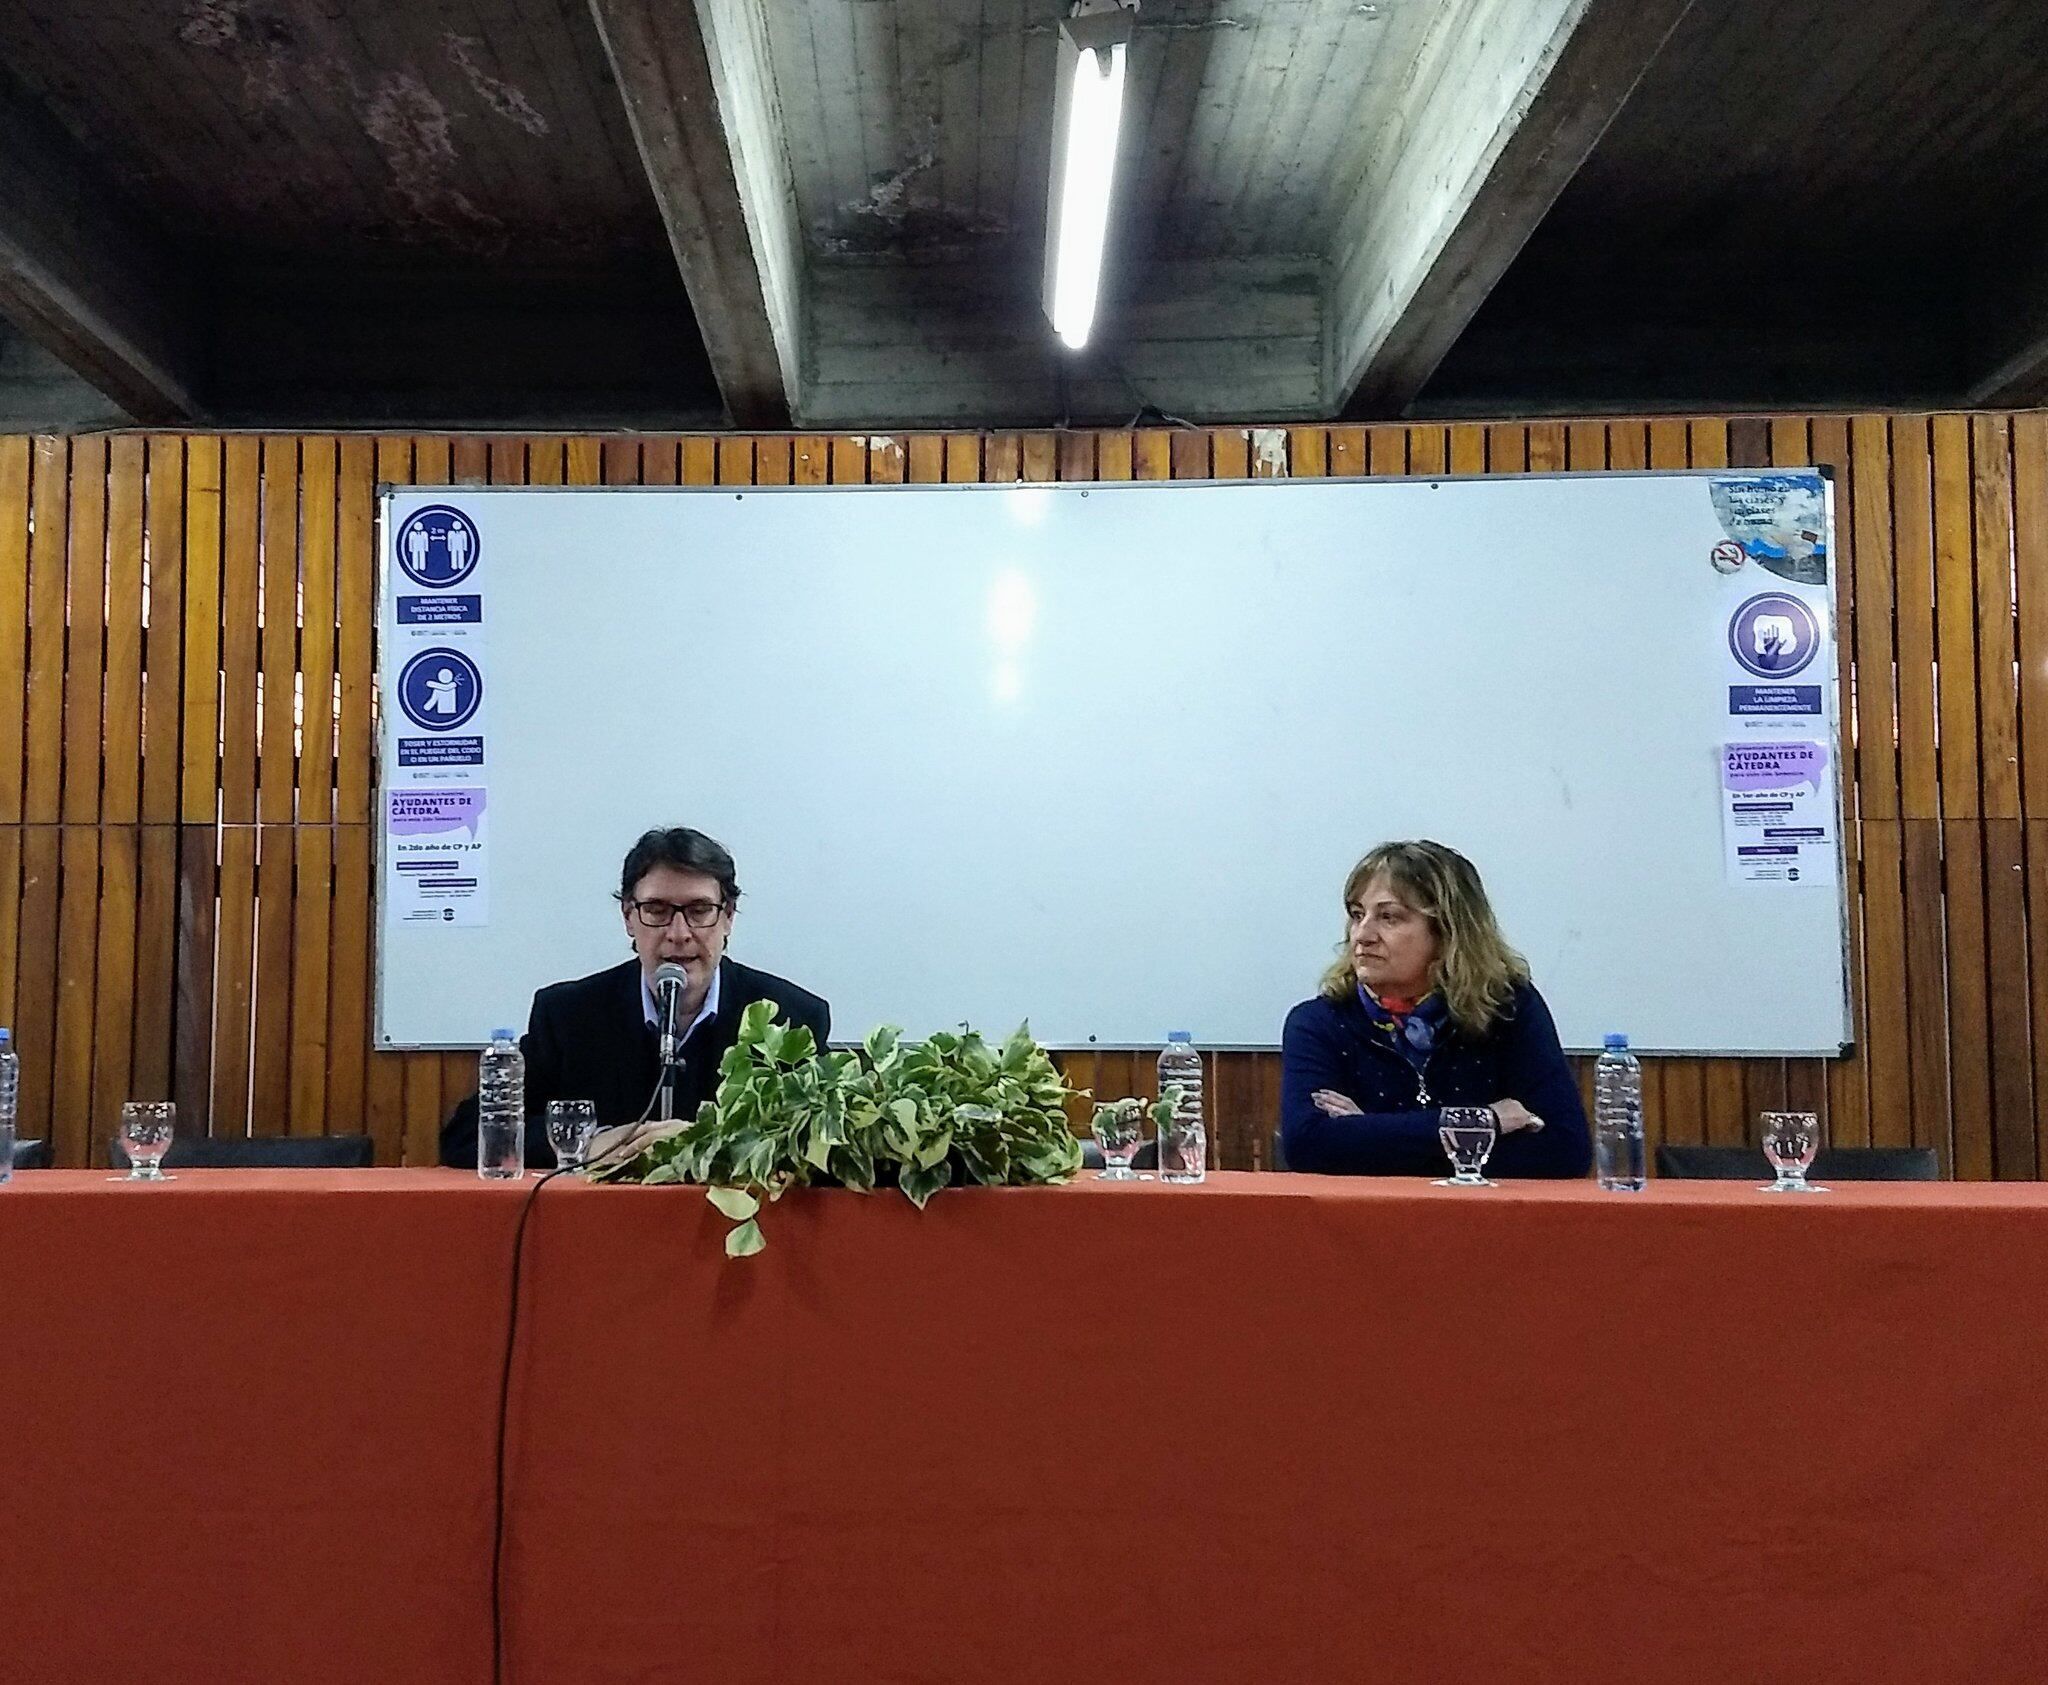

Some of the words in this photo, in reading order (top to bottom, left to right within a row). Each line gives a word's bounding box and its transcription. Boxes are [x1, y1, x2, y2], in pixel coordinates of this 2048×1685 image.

[1728, 751, 1796, 761] AYUDANTES
[1799, 751, 1814, 759] DE
[392, 797, 455, 807] AYUDANTES
[458, 797, 472, 805] DE
